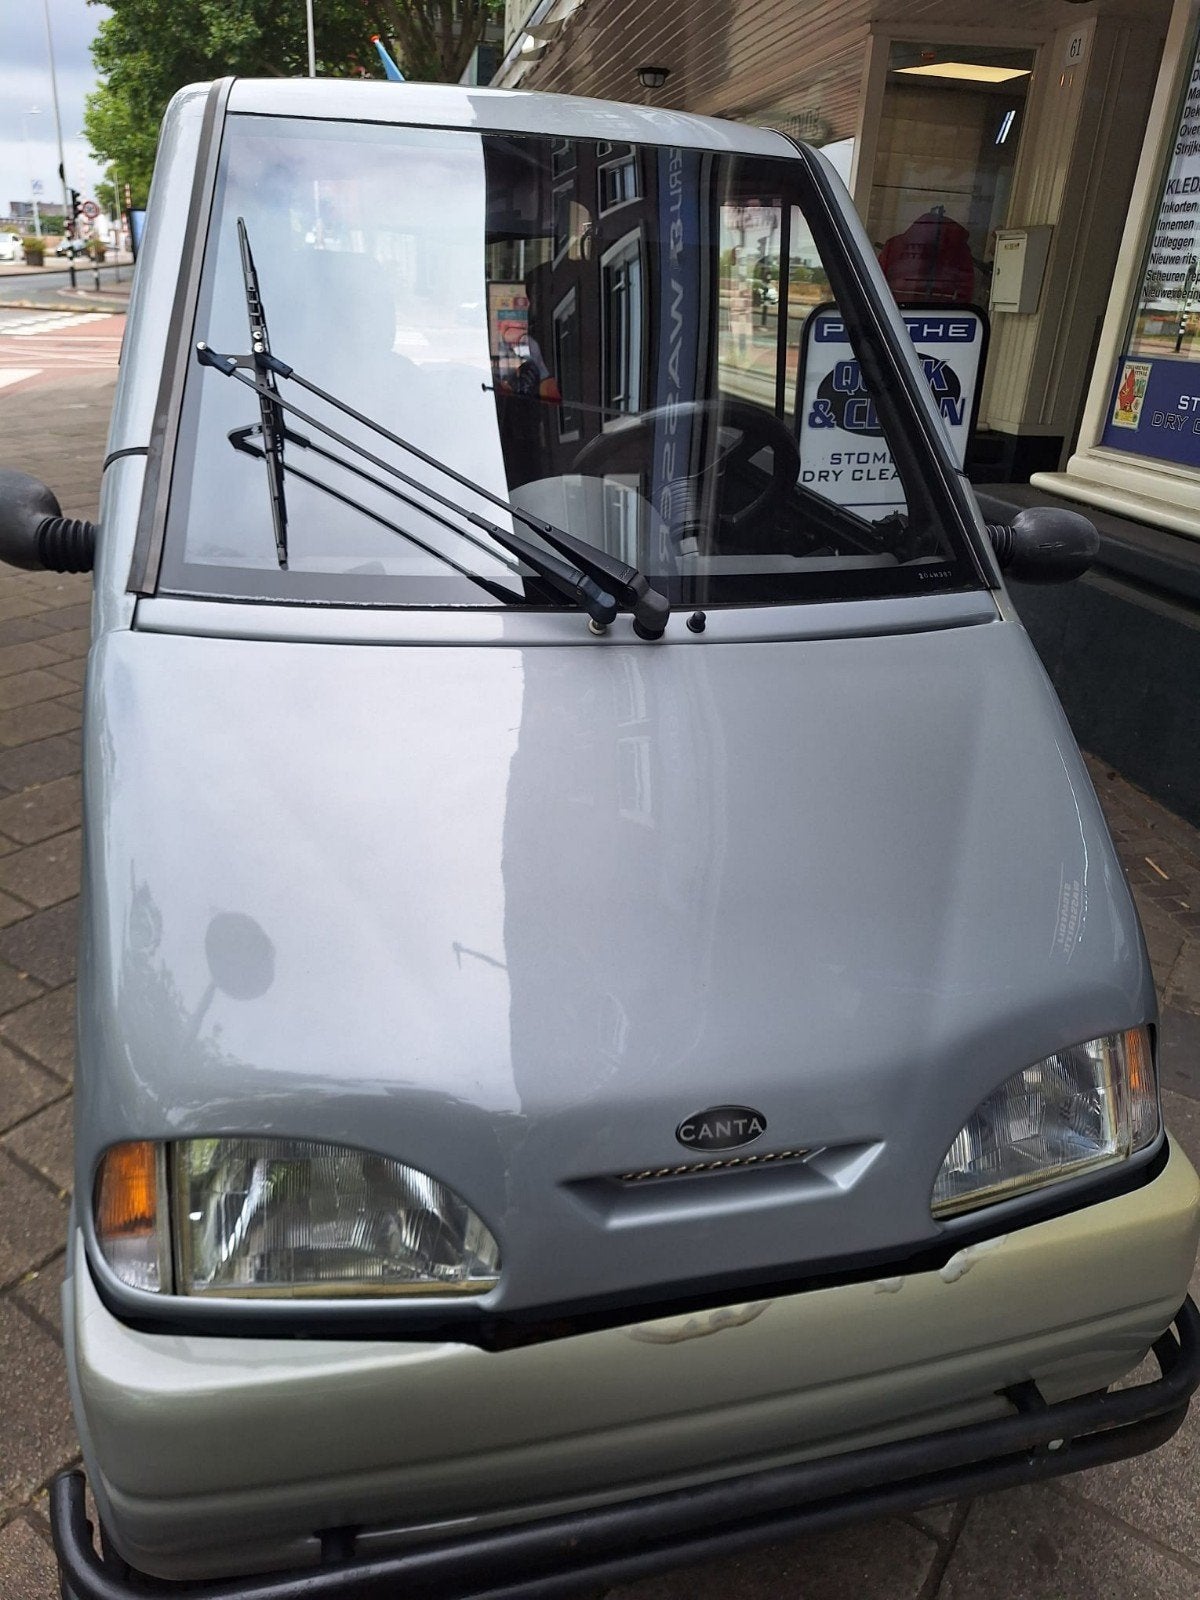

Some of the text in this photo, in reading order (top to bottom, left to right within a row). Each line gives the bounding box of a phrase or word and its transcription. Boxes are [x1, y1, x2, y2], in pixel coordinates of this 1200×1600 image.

[1070, 38, 1082, 57] 61
[1166, 176, 1200, 195] KLED
[1161, 201, 1197, 214] Inkorten
[1157, 219, 1194, 231] Innemen
[1153, 236, 1194, 250] Uitleggen
[1149, 252, 1197, 265] Nieuwe rits
[1146, 269, 1186, 282] Scheuren
[808, 399, 836, 428] &
[1152, 411, 1189, 431] DRY
[803, 470, 842, 482] DRY
[680, 1117, 763, 1141] CANTA
